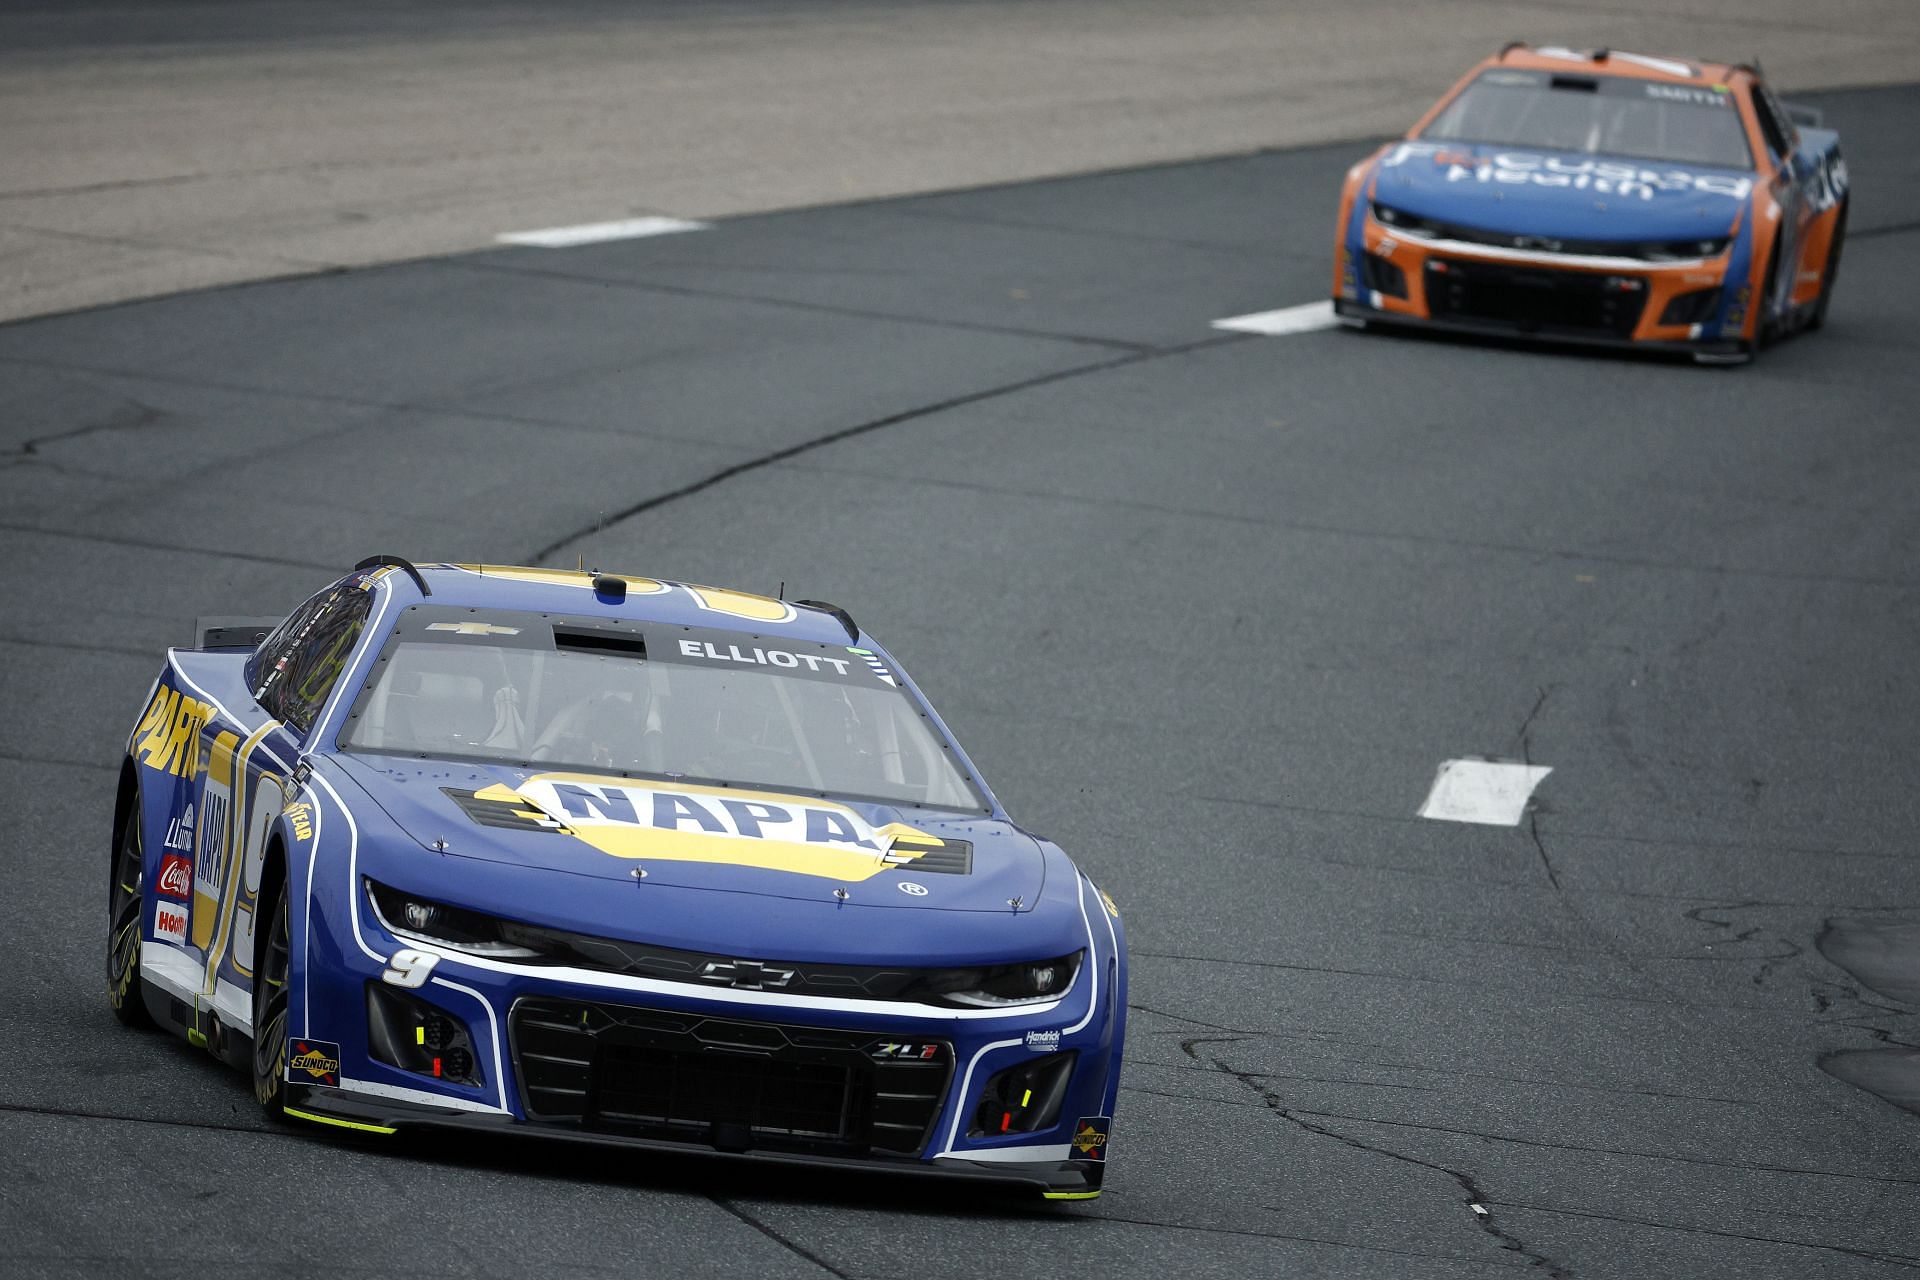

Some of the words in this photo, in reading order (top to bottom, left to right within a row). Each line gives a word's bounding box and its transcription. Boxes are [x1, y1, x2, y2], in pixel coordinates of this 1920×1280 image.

[678, 639, 850, 676] ELLIOTT
[552, 783, 882, 852] NAPA
[198, 789, 227, 888] NAPA
[381, 948, 442, 989] 9
[1026, 1030, 1061, 1045] Hendrick
[292, 1056, 337, 1072] SUNOCO
[871, 1043, 938, 1059] ZL1
[1073, 1133, 1107, 1147] SUNOCO
